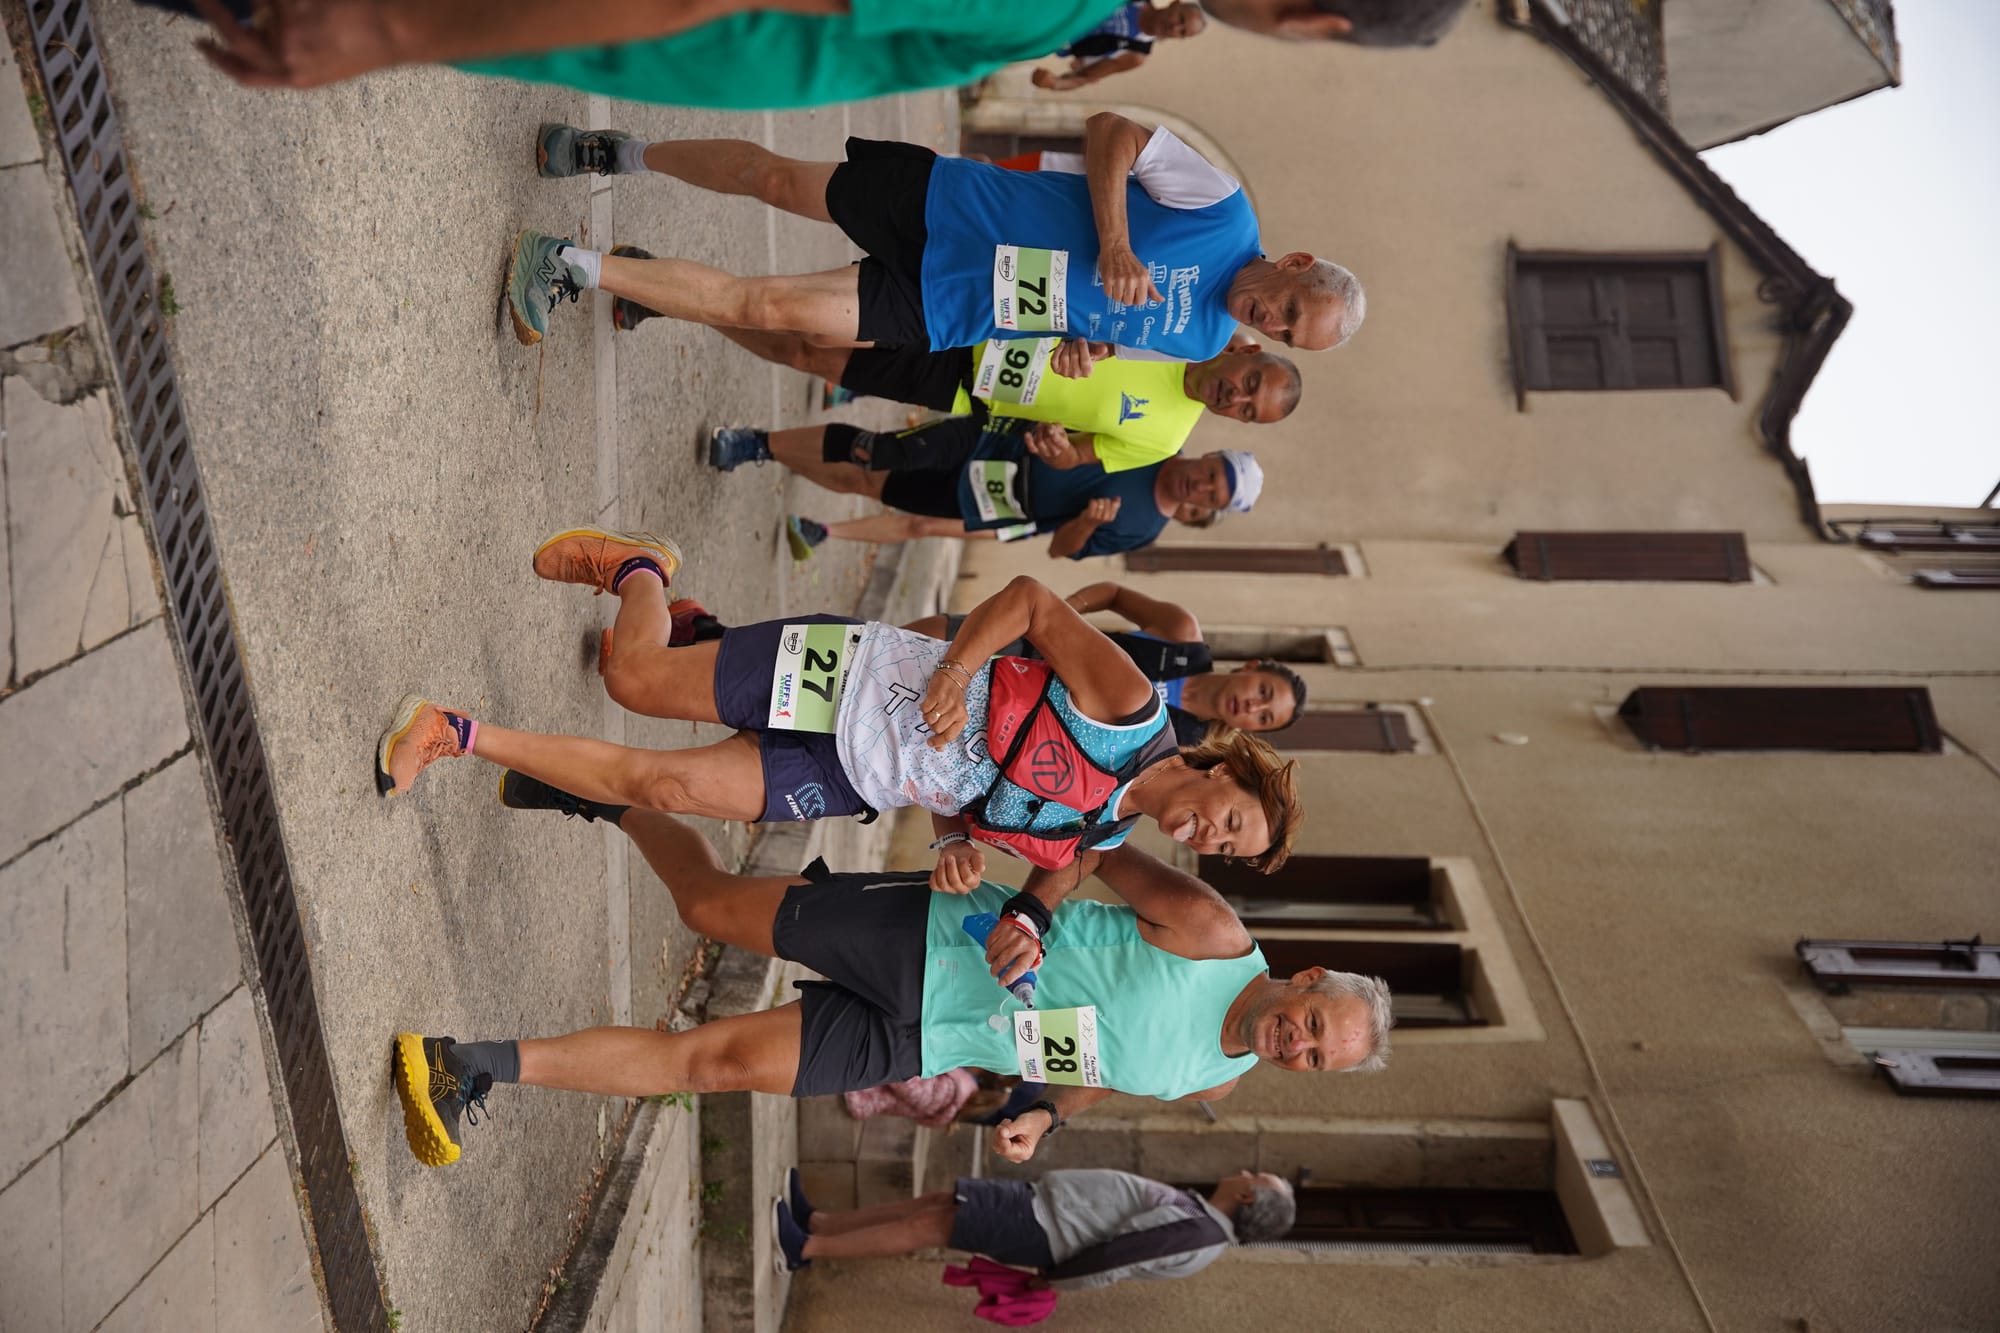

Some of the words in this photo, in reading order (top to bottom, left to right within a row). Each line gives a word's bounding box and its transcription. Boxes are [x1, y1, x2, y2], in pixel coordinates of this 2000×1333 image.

[1018, 277, 1047, 315] 72
[999, 348, 1030, 388] 98
[802, 647, 838, 702] 27
[1043, 1036, 1078, 1072] 28
